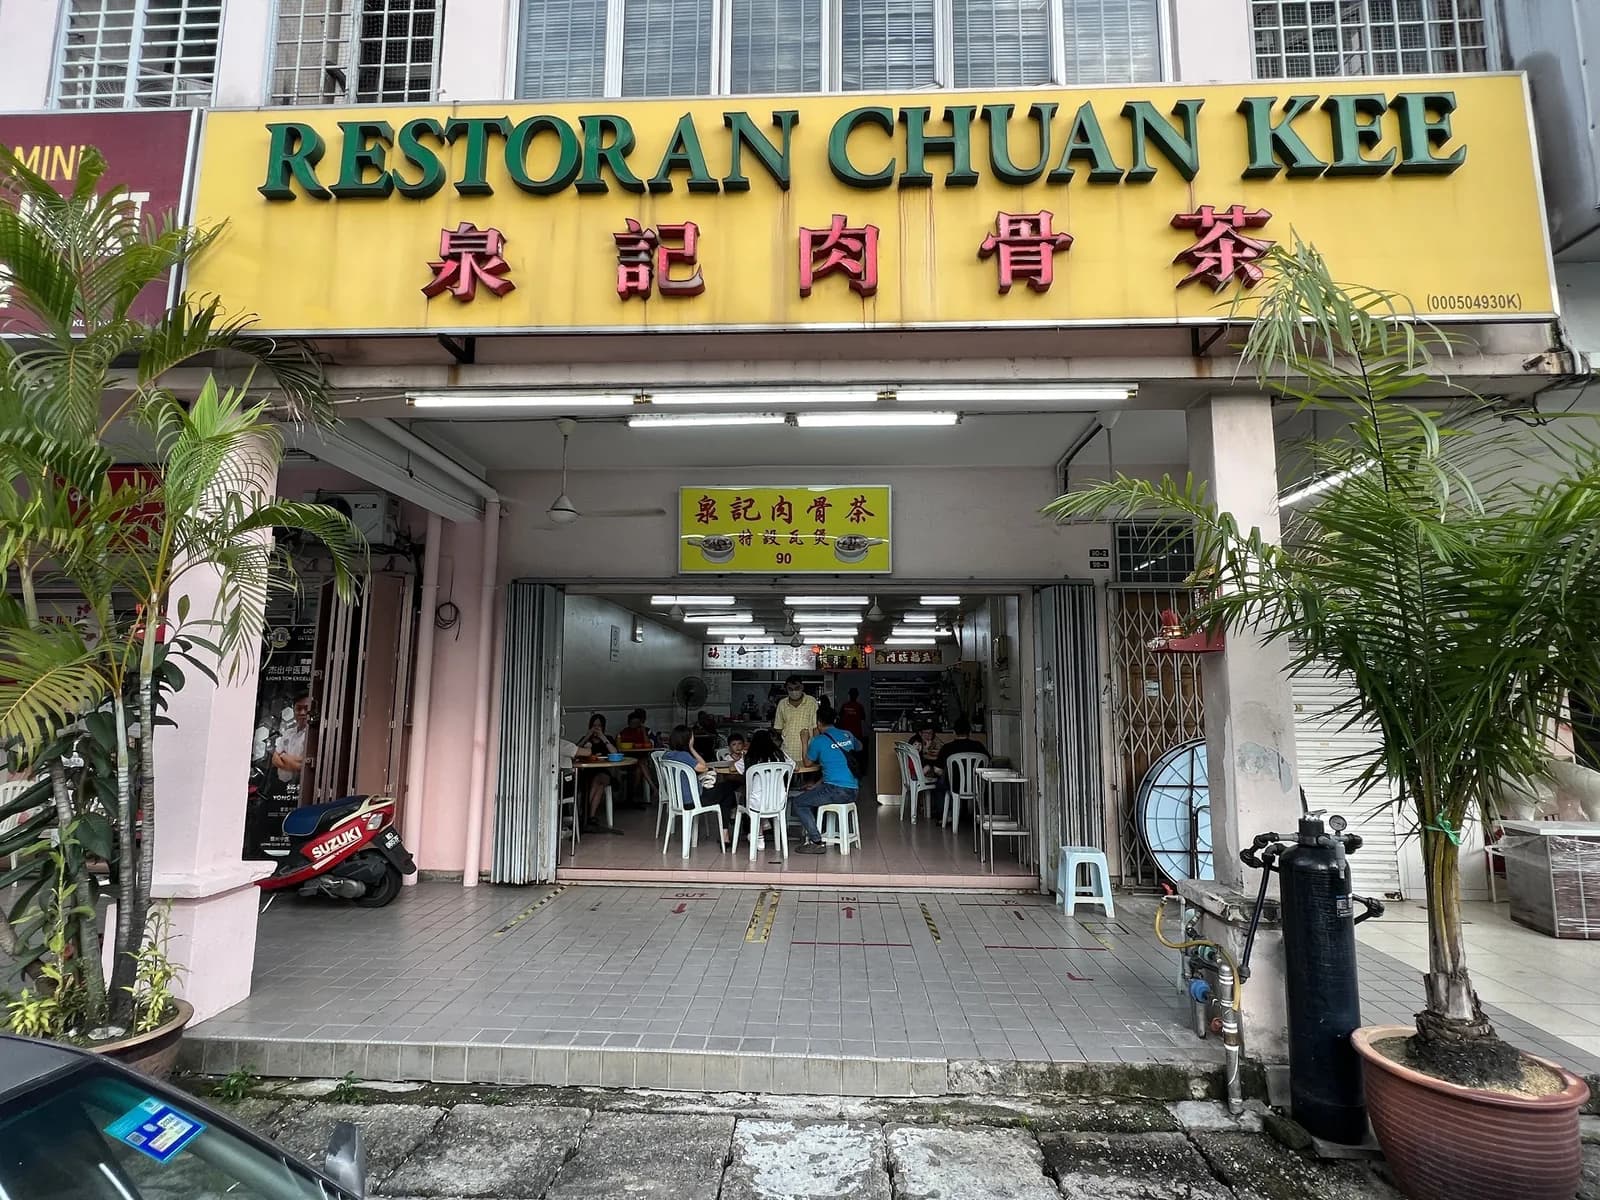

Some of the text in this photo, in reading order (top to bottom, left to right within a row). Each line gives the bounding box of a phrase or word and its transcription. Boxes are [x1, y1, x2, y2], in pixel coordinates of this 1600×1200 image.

[258, 91, 1468, 201] RESTORAN CHUAN KEE
[420, 204, 1278, 303] 泉記肉骨茶
[1427, 293, 1522, 312] (000504930K)
[695, 494, 876, 525] 泉記肉骨茶
[776, 553, 792, 564] 90
[311, 826, 363, 859] SUZUKI
